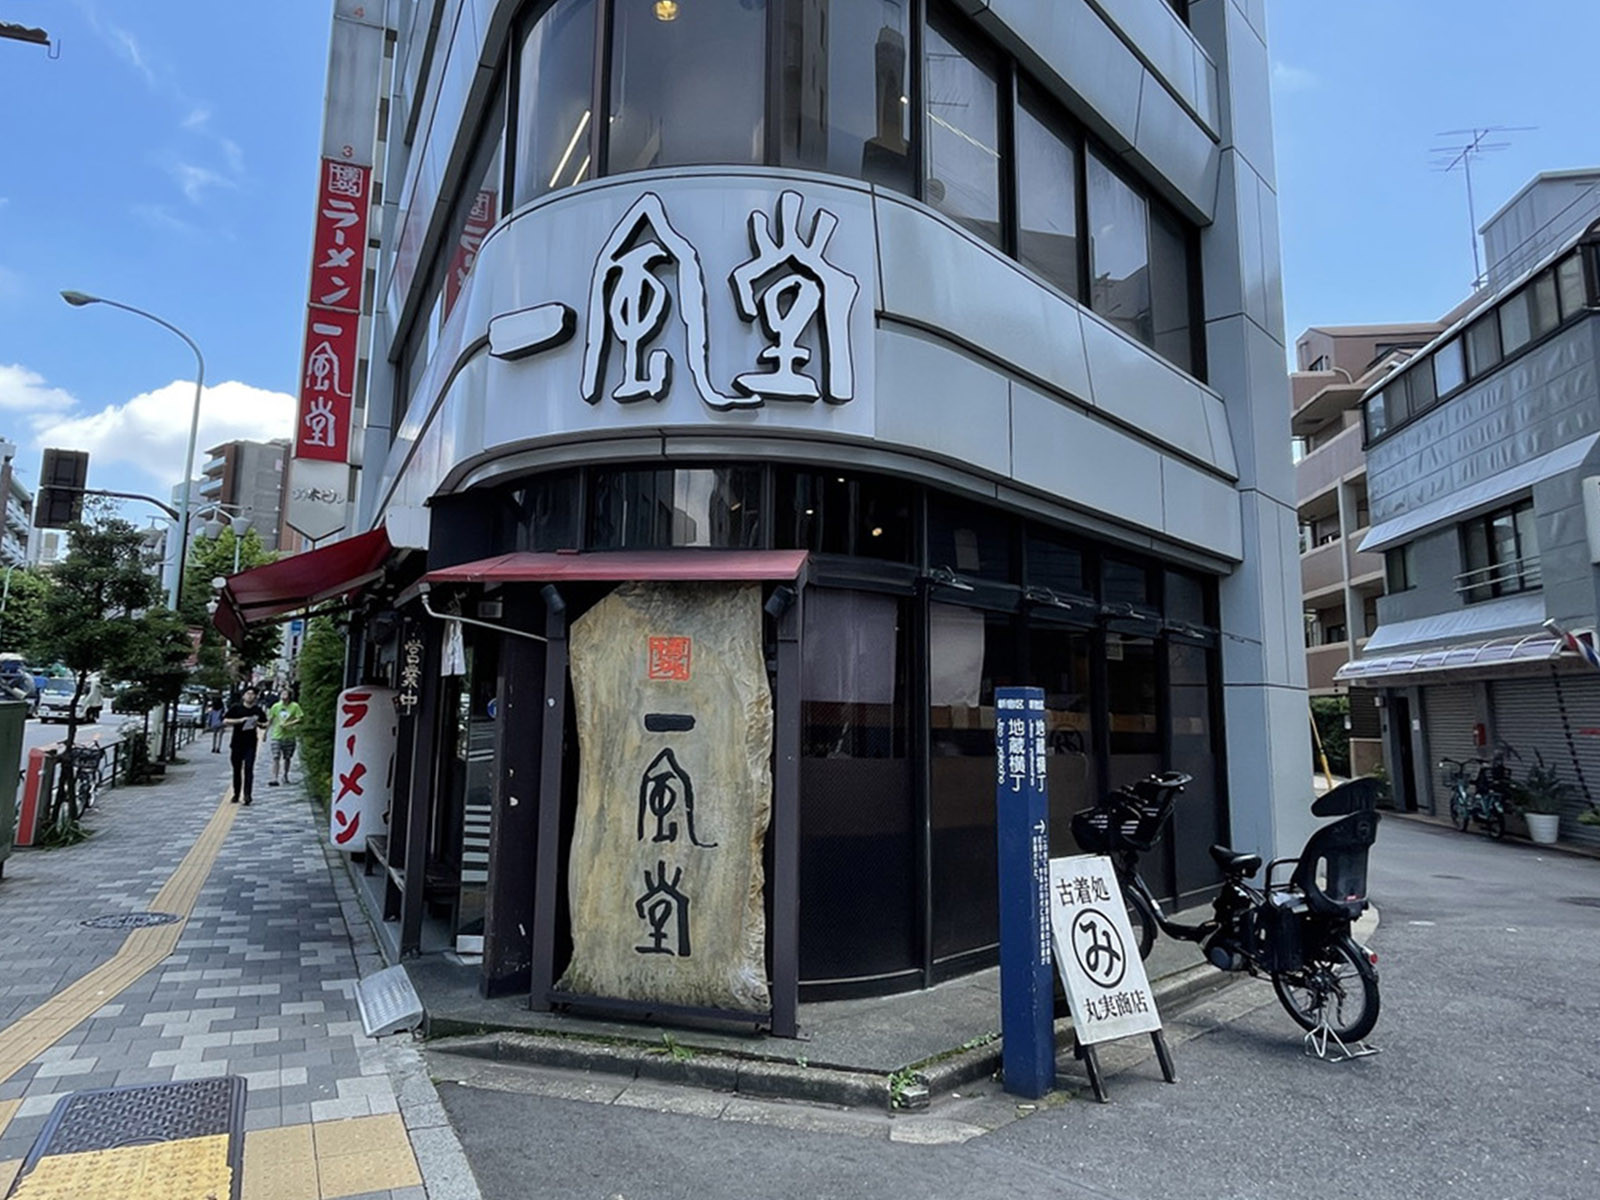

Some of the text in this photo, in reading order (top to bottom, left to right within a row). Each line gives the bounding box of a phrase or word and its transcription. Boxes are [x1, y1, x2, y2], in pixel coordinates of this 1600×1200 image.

[342, 145, 354, 158] 3
[318, 199, 360, 304] ラーメン
[488, 189, 860, 411] 一風堂
[303, 323, 352, 447] 一風堂
[400, 639, 425, 716] 営業中
[335, 693, 373, 845] ラーメン
[1008, 718, 1026, 792] 地蔵横丁
[634, 713, 718, 957] 一風堂
[1056, 875, 1111, 907] 古着処
[1079, 920, 1121, 977] み
[1084, 990, 1149, 1023] 丸実商店
